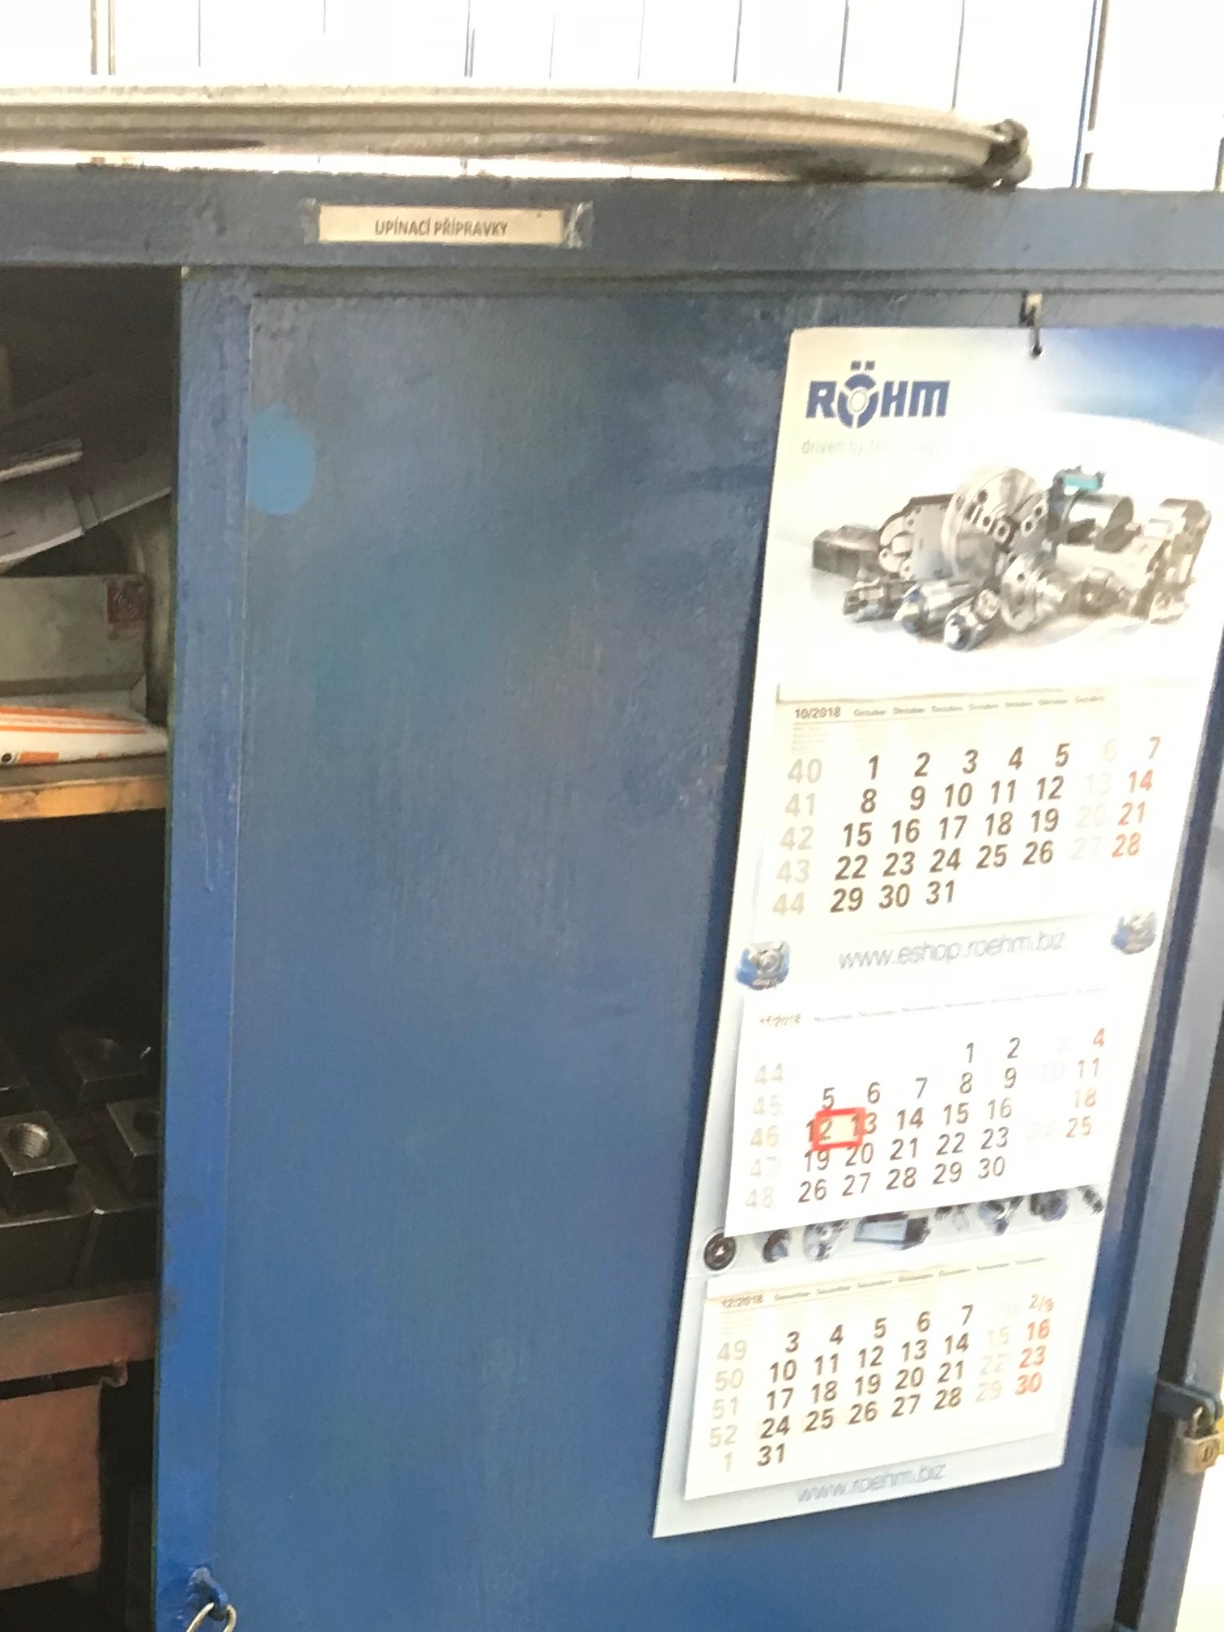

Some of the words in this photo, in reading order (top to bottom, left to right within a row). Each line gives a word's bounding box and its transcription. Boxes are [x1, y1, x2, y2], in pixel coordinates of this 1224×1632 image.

[375, 216, 431, 236] UPÍNACÍ
[434, 216, 508, 237] PŘÍPRAVKY
[805, 360, 951, 429] RÖHM
[868, 755, 880, 780] 1
[913, 752, 931, 777] 2
[962, 749, 979, 774] 3
[1008, 746, 1024, 770] 4
[1055, 742, 1071, 768] 5
[1148, 736, 1161, 760] 7
[860, 788, 877, 814] 8
[910, 785, 926, 811] 9
[944, 782, 973, 808] 10
[991, 779, 1017, 805] 11
[1036, 775, 1064, 800] 12
[1128, 769, 1154, 793] 14
[843, 821, 873, 848] 15
[891, 818, 921, 844] 16
[939, 815, 968, 840] 17
[985, 811, 1013, 837] 18
[1031, 808, 1060, 833] 19
[1118, 801, 1146, 826] 21
[834, 854, 868, 881] 22
[882, 851, 916, 877] 23
[929, 847, 961, 873] 24
[976, 844, 1008, 870] 25
[1022, 840, 1054, 866] 26
[1111, 832, 1142, 858] 28
[829, 887, 864, 913] 29
[878, 883, 911, 909] 30
[925, 879, 955, 905] 31
[966, 1042, 974, 1063] 1
[1007, 1036, 1021, 1059] 2
[1092, 1028, 1105, 1048] 4
[822, 1087, 835, 1110] 5
[867, 1081, 881, 1104] 6
[915, 1076, 928, 1099] 7
[959, 1072, 973, 1094] 8
[1004, 1067, 1017, 1089] 9
[1078, 1057, 1101, 1079] 11
[897, 1107, 924, 1131] 14
[943, 1102, 969, 1126] 15
[987, 1097, 1012, 1120] 16
[1074, 1087, 1098, 1109] 18
[804, 1148, 830, 1172] 19
[844, 1142, 874, 1167] 20
[889, 1137, 918, 1161] 21
[936, 1131, 966, 1156] 22
[980, 1126, 1009, 1151] 23
[1065, 1115, 1092, 1138] 25
[797, 1178, 827, 1204] 26
[841, 1171, 871, 1197] 27
[885, 1166, 917, 1191] 28
[932, 1161, 963, 1186] 29
[977, 1155, 1006, 1180] 30
[769, 1358, 798, 1384] 10
[814, 1352, 840, 1376] 11
[858, 1345, 885, 1369] 12
[901, 1339, 928, 1363] 13
[944, 1332, 970, 1356] 14
[1026, 1318, 1051, 1341] 16
[784, 1331, 801, 1354] 3
[829, 1323, 845, 1346] 4
[873, 1317, 888, 1340] 5
[916, 1310, 931, 1333] 6
[961, 1304, 974, 1327] 7
[766, 1387, 795, 1412] 17
[811, 1379, 839, 1405] 18
[854, 1373, 882, 1397] 19
[895, 1366, 924, 1391] 20
[937, 1360, 964, 1384] 21
[1018, 1345, 1046, 1369] 23
[759, 1414, 791, 1440] 24
[802, 1407, 835, 1433] 25
[847, 1400, 878, 1426] 26
[890, 1393, 921, 1418] 27
[932, 1386, 963, 1411] 28
[1015, 1372, 1043, 1395] 30
[756, 1442, 786, 1467] 31
